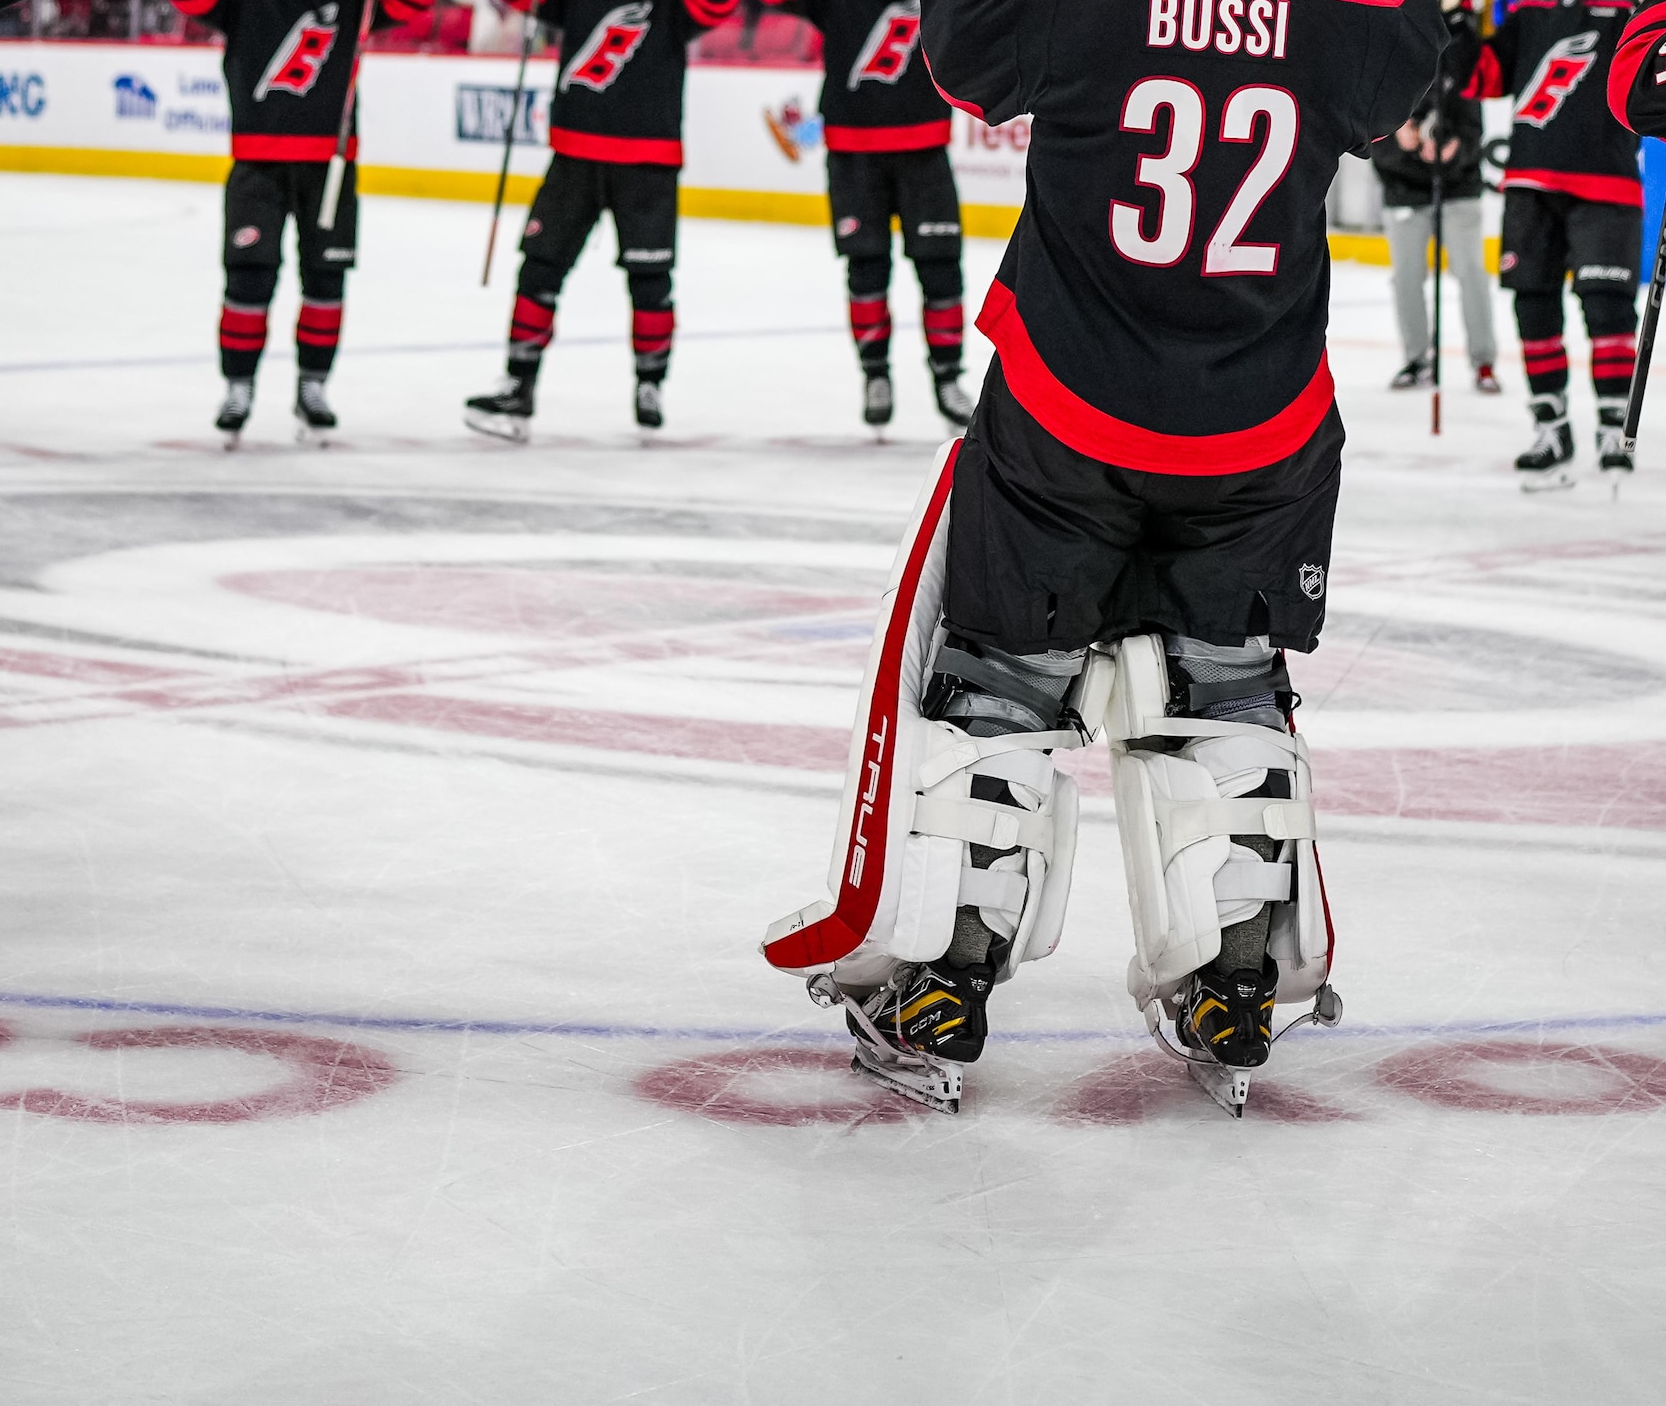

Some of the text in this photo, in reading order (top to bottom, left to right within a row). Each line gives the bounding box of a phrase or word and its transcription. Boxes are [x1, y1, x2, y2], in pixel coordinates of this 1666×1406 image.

[1108, 75, 1300, 277] 32
[1304, 574, 1321, 592] NHL
[848, 715, 889, 889] TRUE
[909, 1010, 942, 1036] CCM
